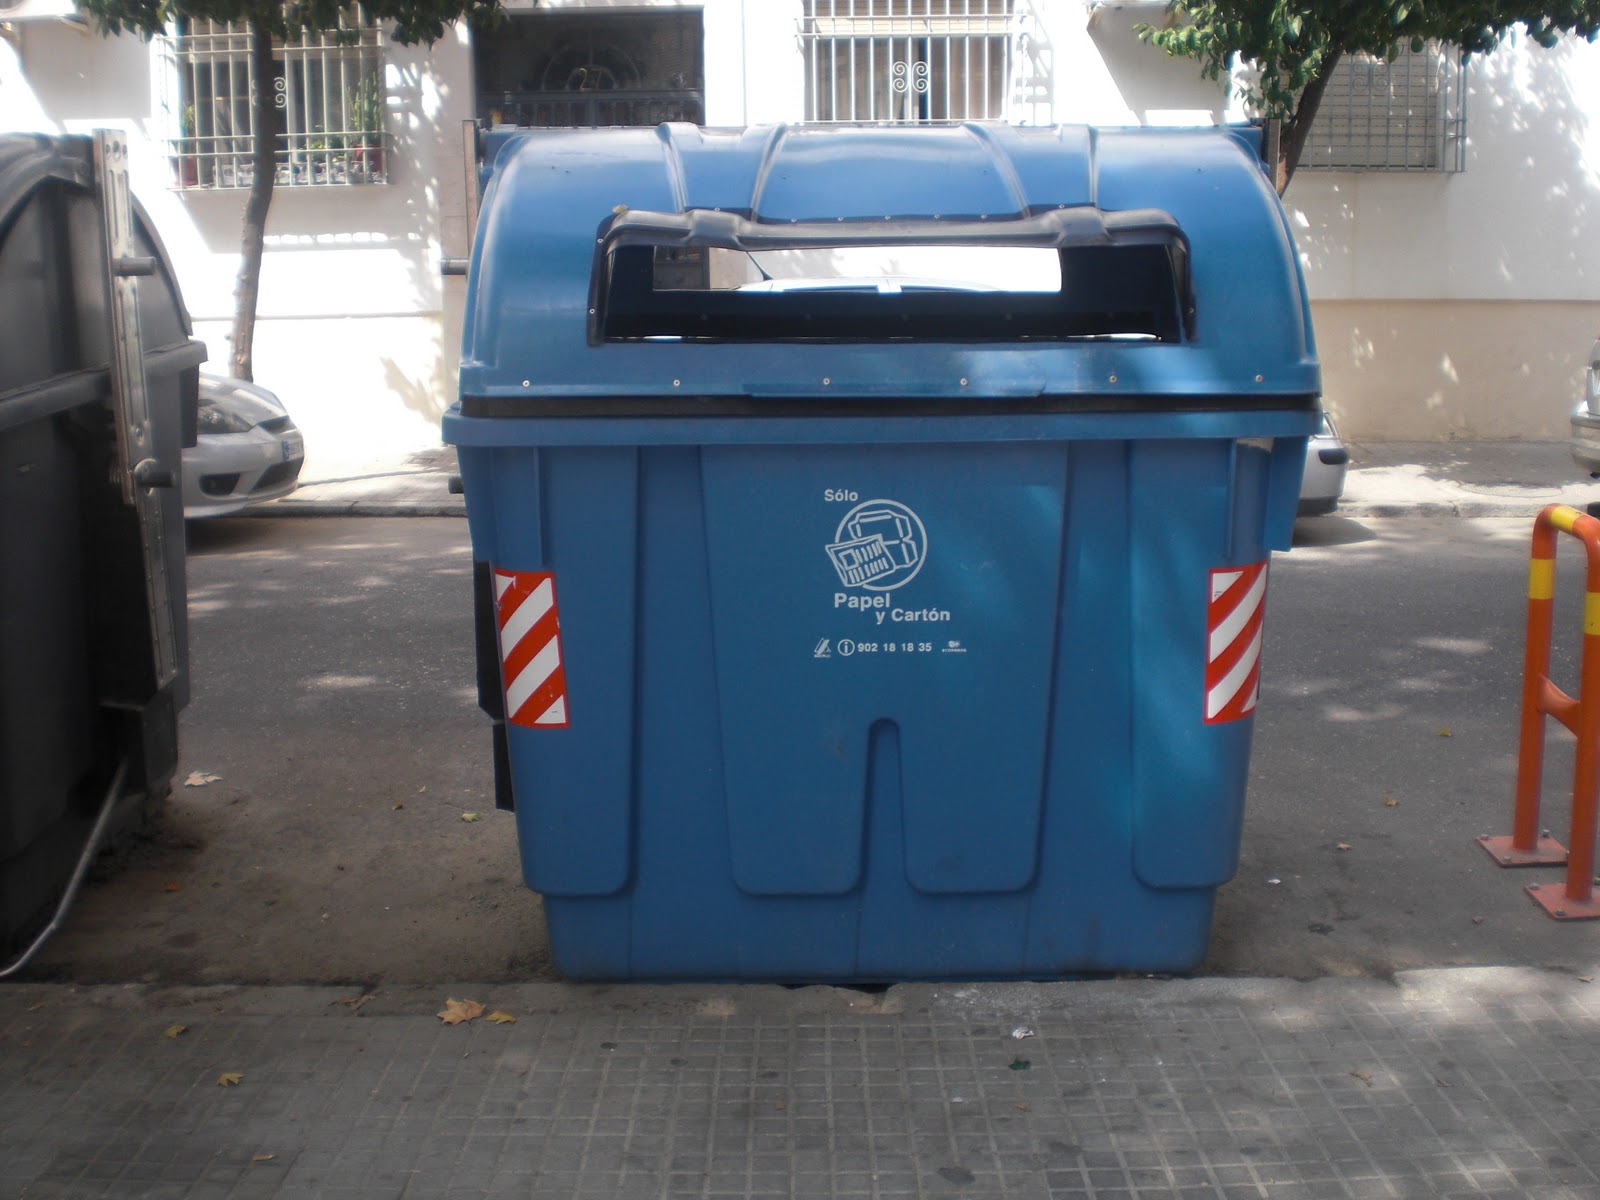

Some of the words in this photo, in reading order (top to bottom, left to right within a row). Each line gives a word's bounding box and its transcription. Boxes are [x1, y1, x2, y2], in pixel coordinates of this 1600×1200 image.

[579, 67, 602, 90] 27
[824, 489, 859, 502] Sólo
[834, 592, 891, 612] Papel
[876, 611, 885, 625] y
[891, 608, 951, 622] Cartón
[857, 642, 878, 652] 902
[883, 642, 896, 652] 18
[901, 642, 914, 652] 18
[918, 642, 932, 652] 35
